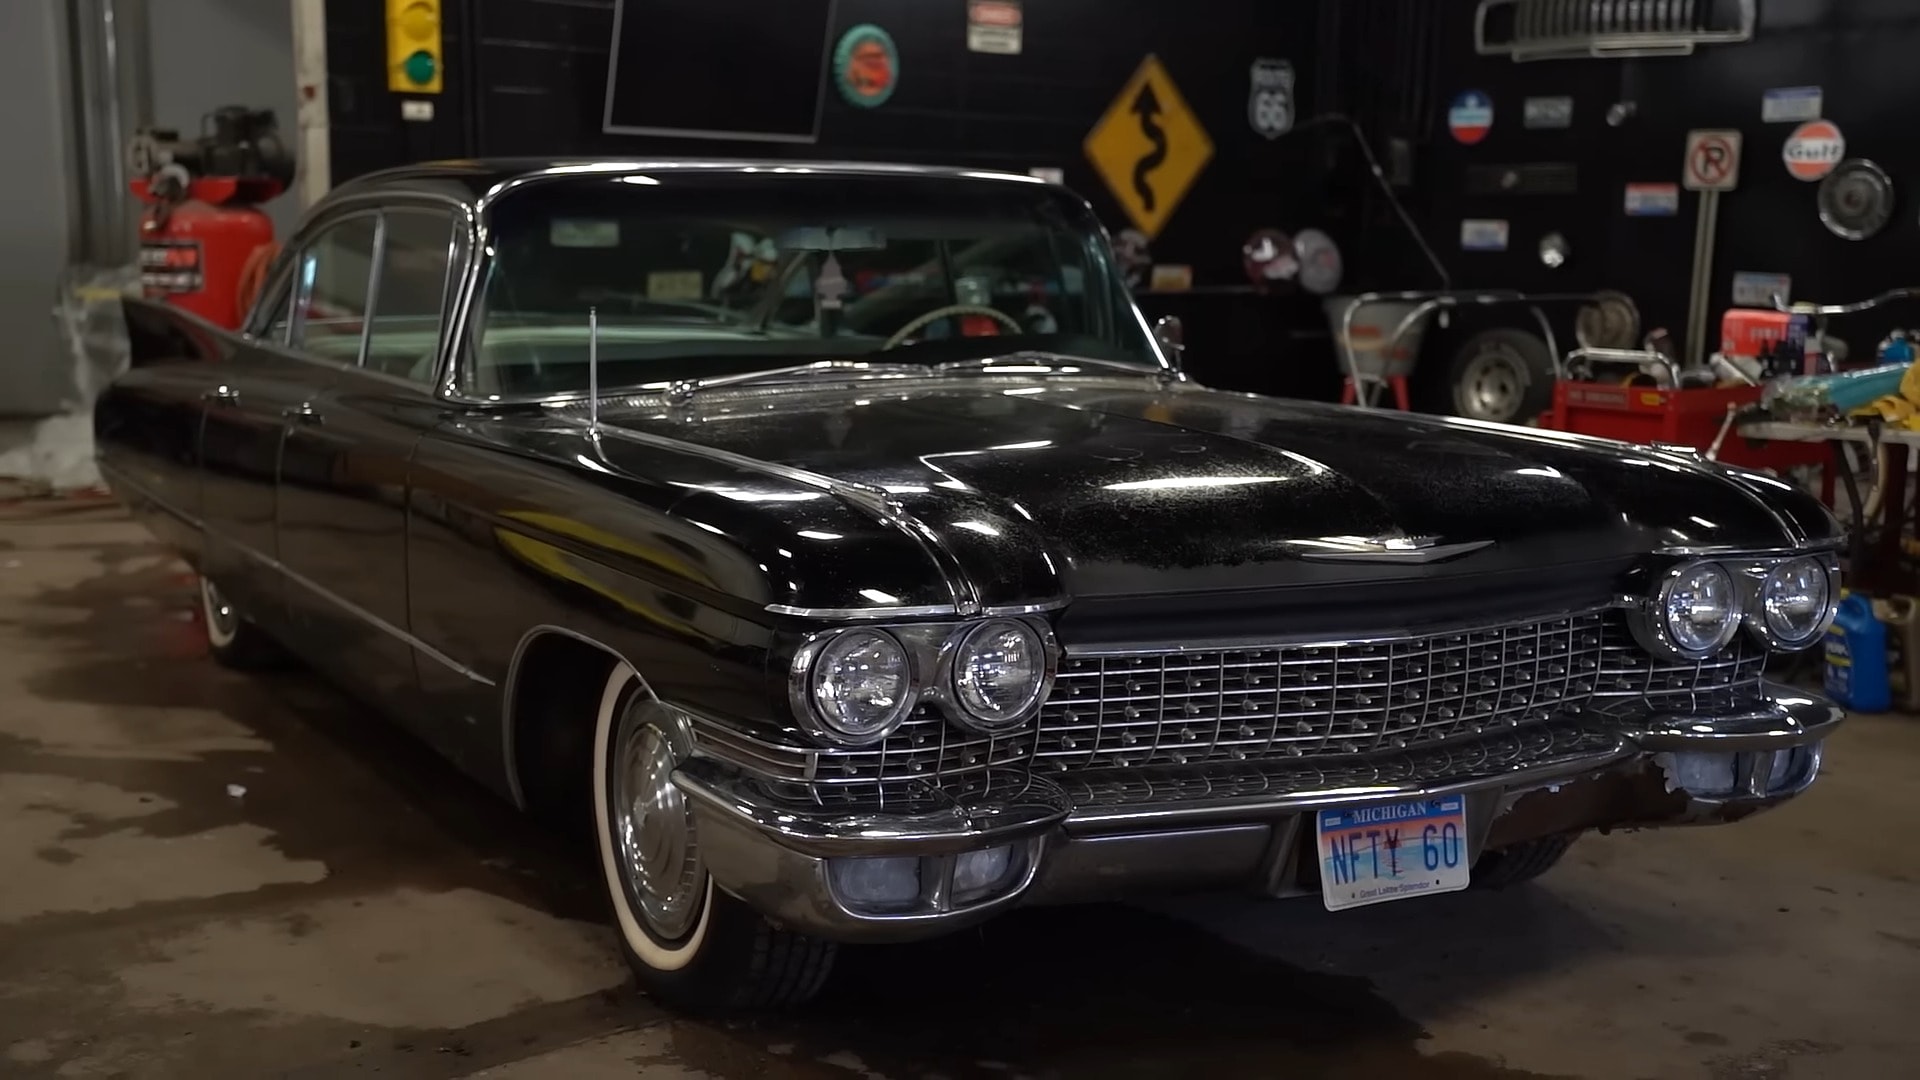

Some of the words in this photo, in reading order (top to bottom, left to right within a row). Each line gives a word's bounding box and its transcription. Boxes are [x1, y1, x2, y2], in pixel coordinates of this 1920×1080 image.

[1256, 93, 1286, 129] 66
[1788, 143, 1840, 158] Gulf
[1353, 801, 1427, 824] MICHIGAN
[1331, 828, 1400, 885] NFTY
[1423, 822, 1458, 871] 60
